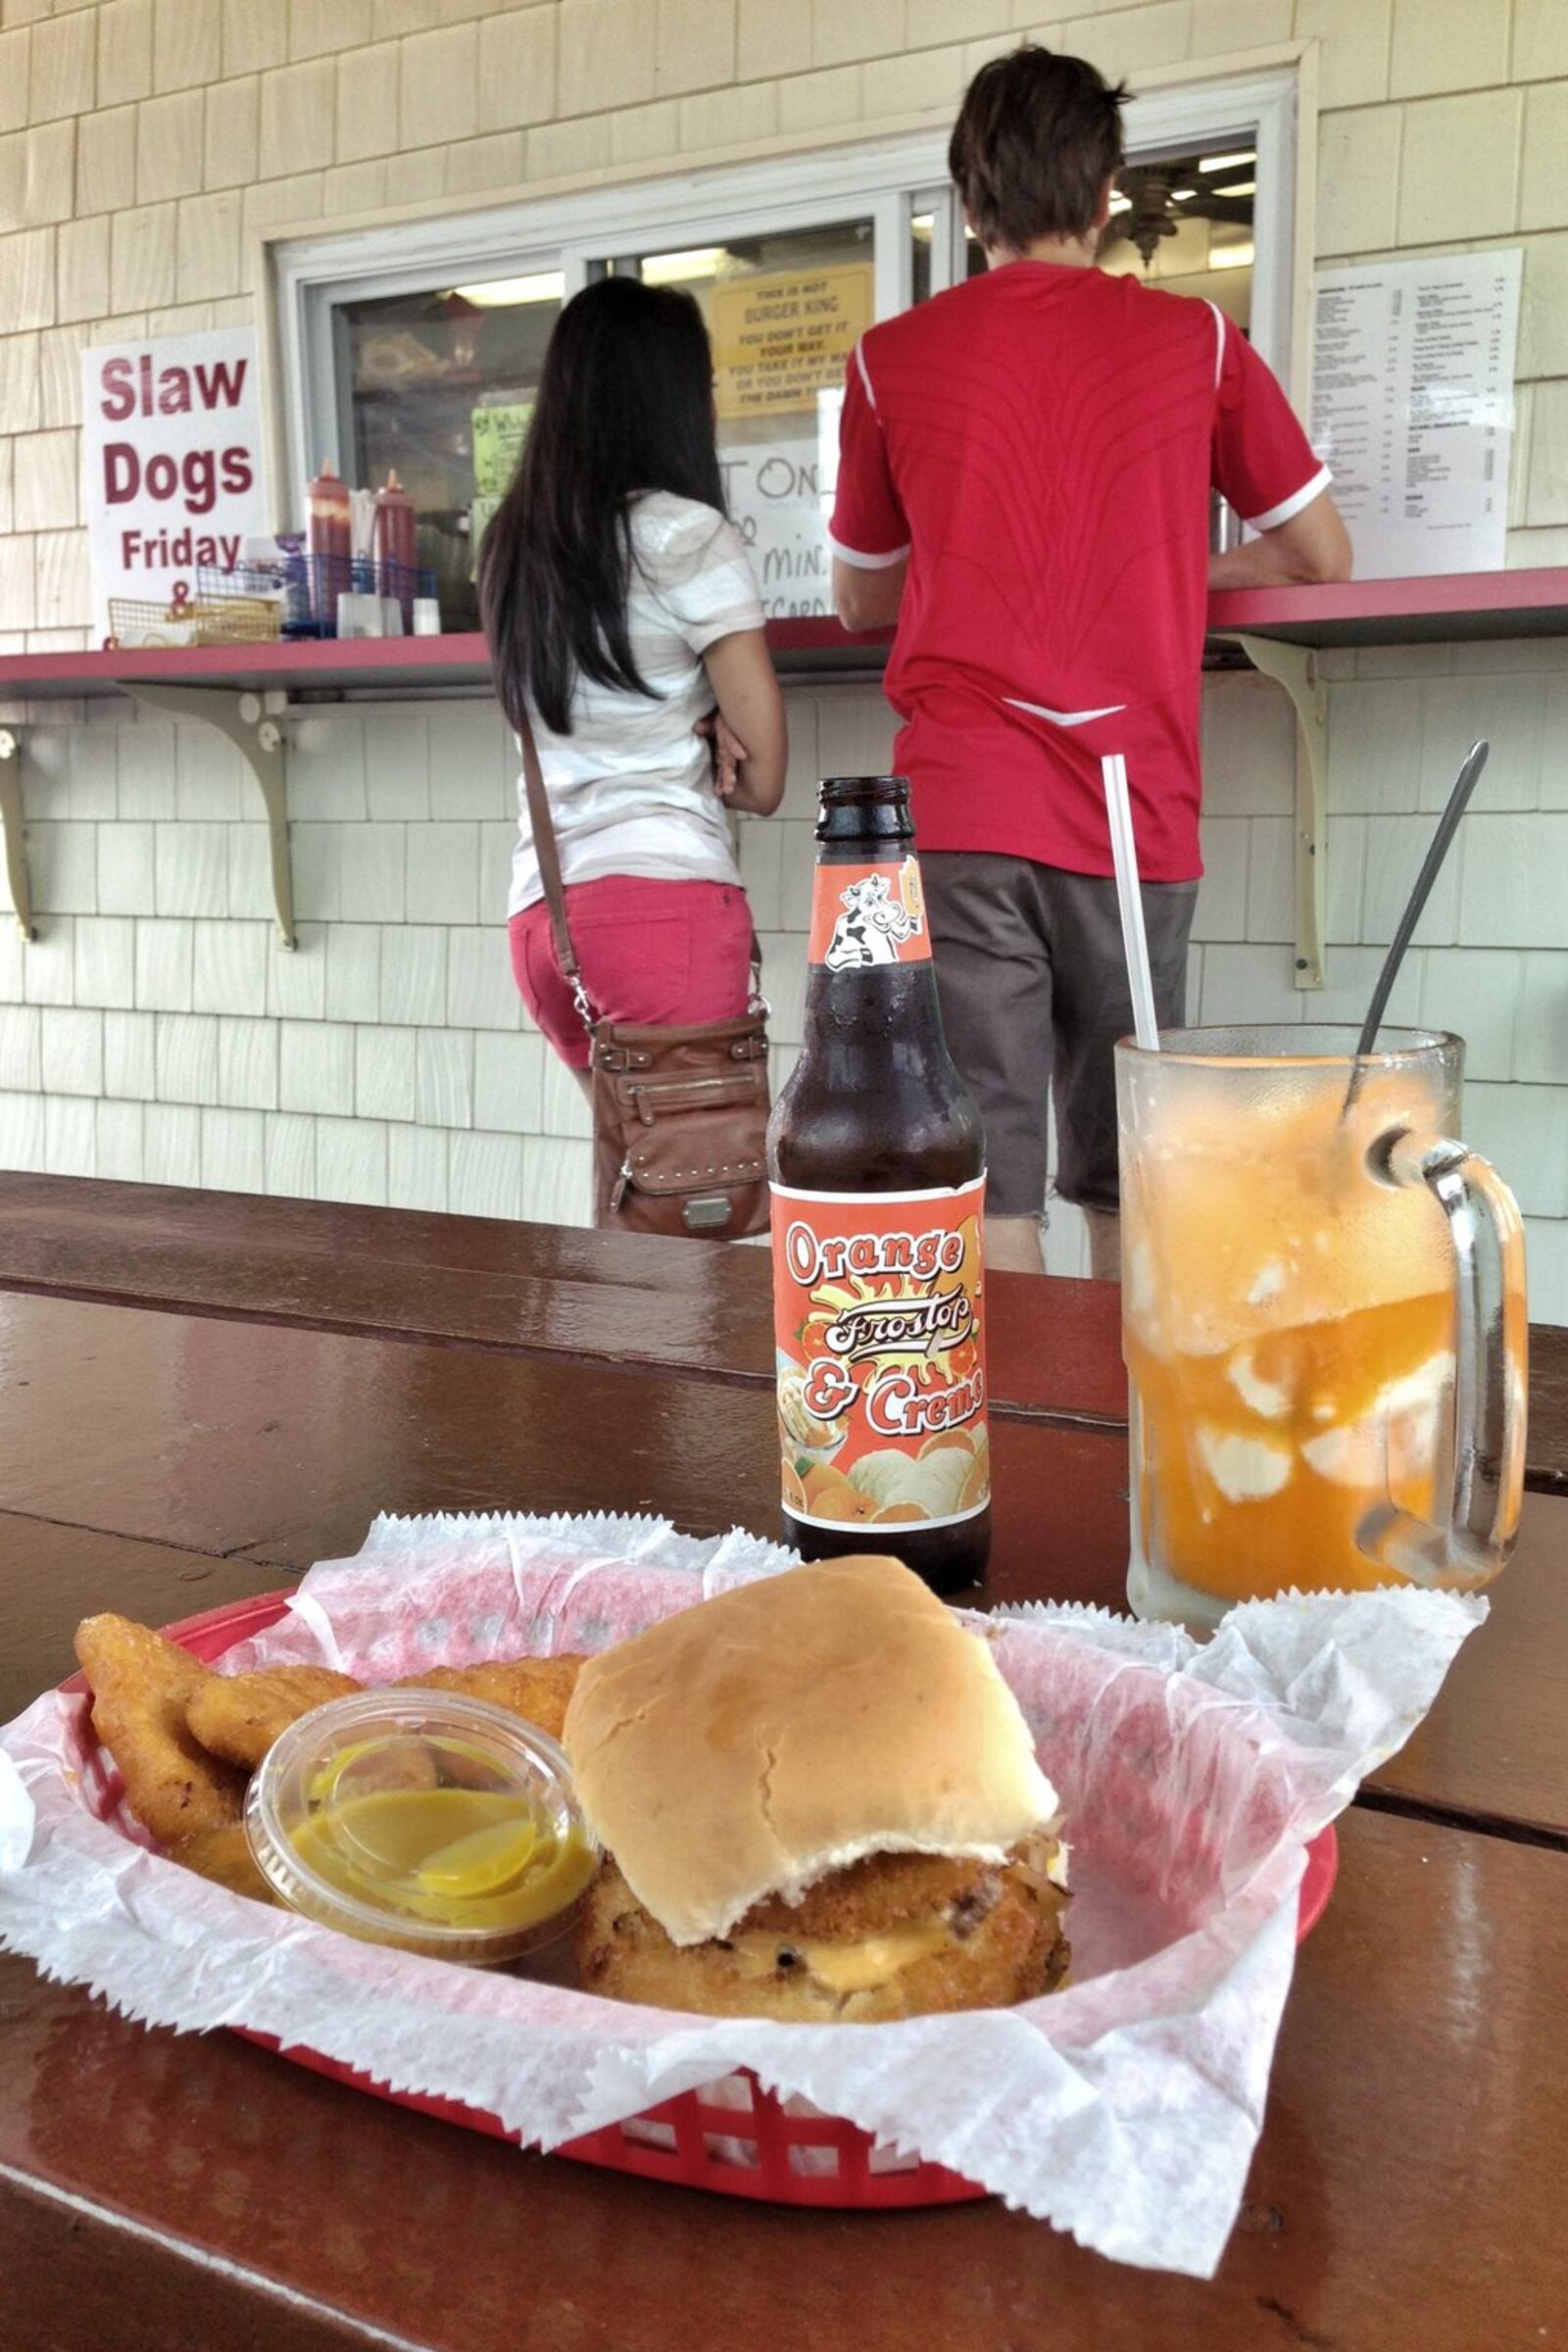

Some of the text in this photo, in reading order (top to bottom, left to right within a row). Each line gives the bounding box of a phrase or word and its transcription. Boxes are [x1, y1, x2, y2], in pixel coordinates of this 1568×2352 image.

[745, 295, 839, 323] BURGER KING
[757, 280, 827, 300] THIS IS NOT
[739, 320, 849, 345] YOU DON'T GET IT
[760, 343, 794, 357] YOUR
[729, 363, 754, 374] YOU
[758, 358, 788, 370] TAKE
[101, 355, 248, 421] Slaw
[103, 443, 253, 514] Dogs
[122, 527, 241, 576] Friday
[169, 581, 195, 619] &
[788, 1222, 964, 1285] Orange
[825, 1283, 972, 1360] Frostop
[805, 1357, 858, 1417] &
